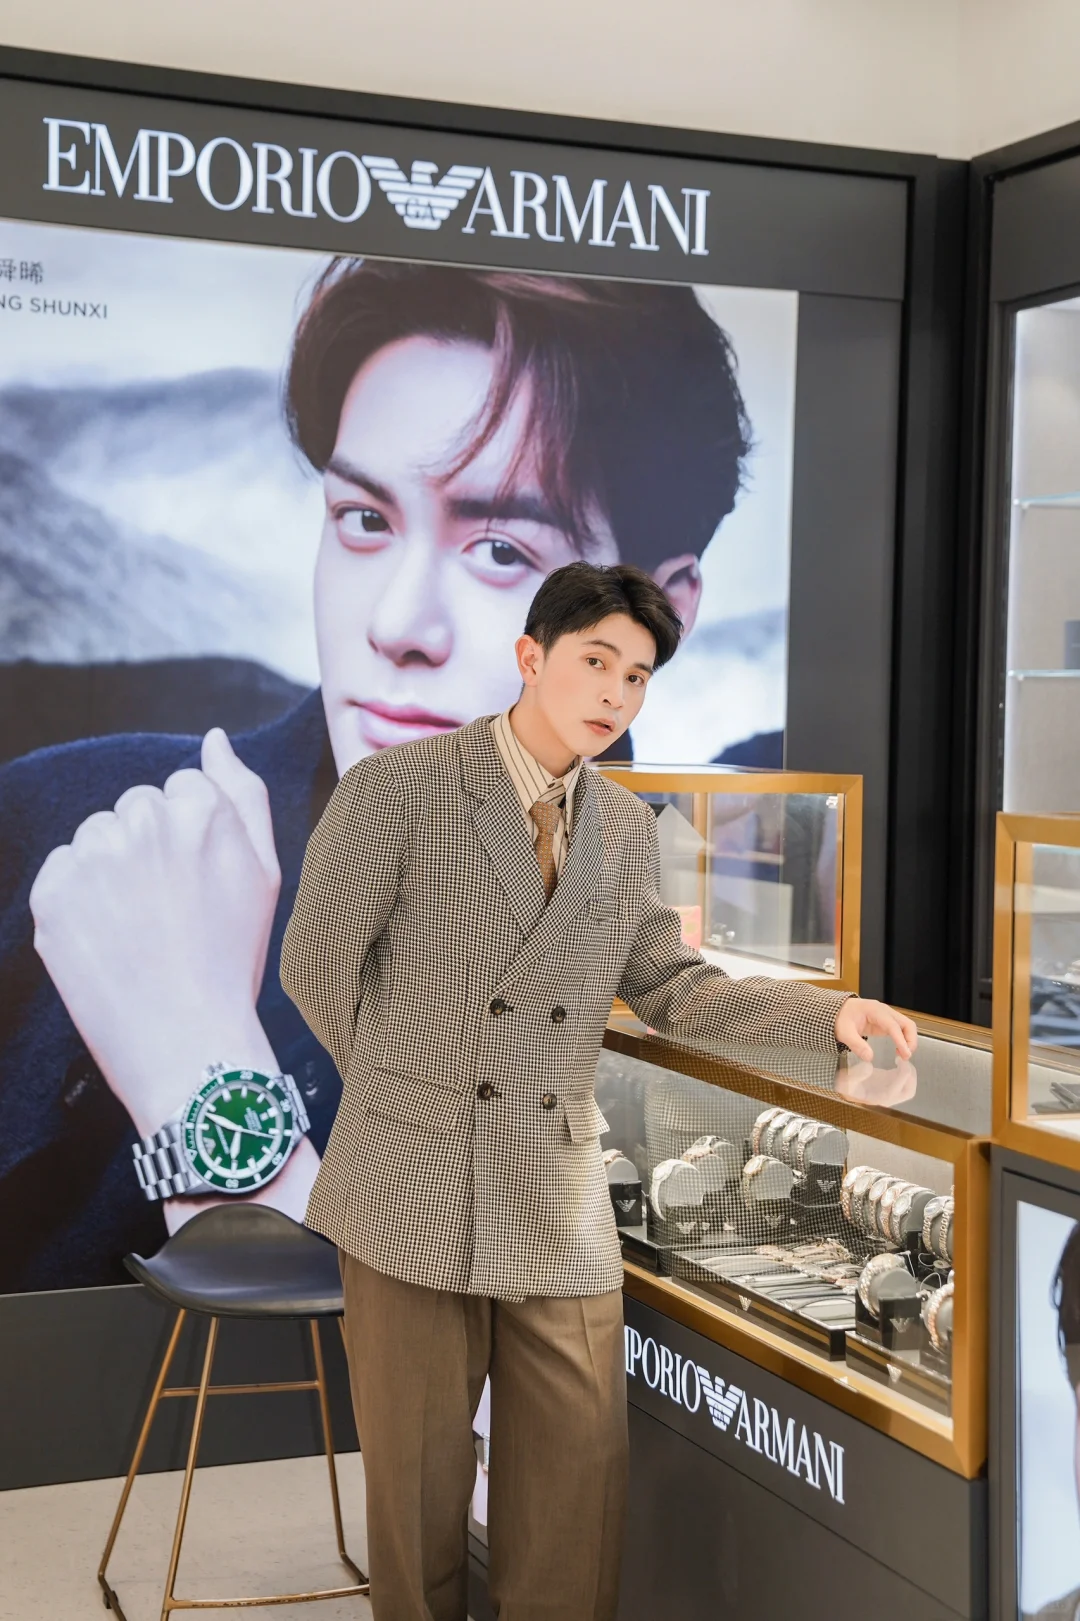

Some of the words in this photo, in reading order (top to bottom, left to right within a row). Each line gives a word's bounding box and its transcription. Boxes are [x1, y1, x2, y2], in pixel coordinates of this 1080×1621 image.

[42, 117, 372, 224] EMPORIO
[462, 166, 711, 257] ARMANI
[30, 297, 108, 319] SHUNXI
[624, 1324, 701, 1414] PORIO
[734, 1390, 845, 1505] ARMANI
